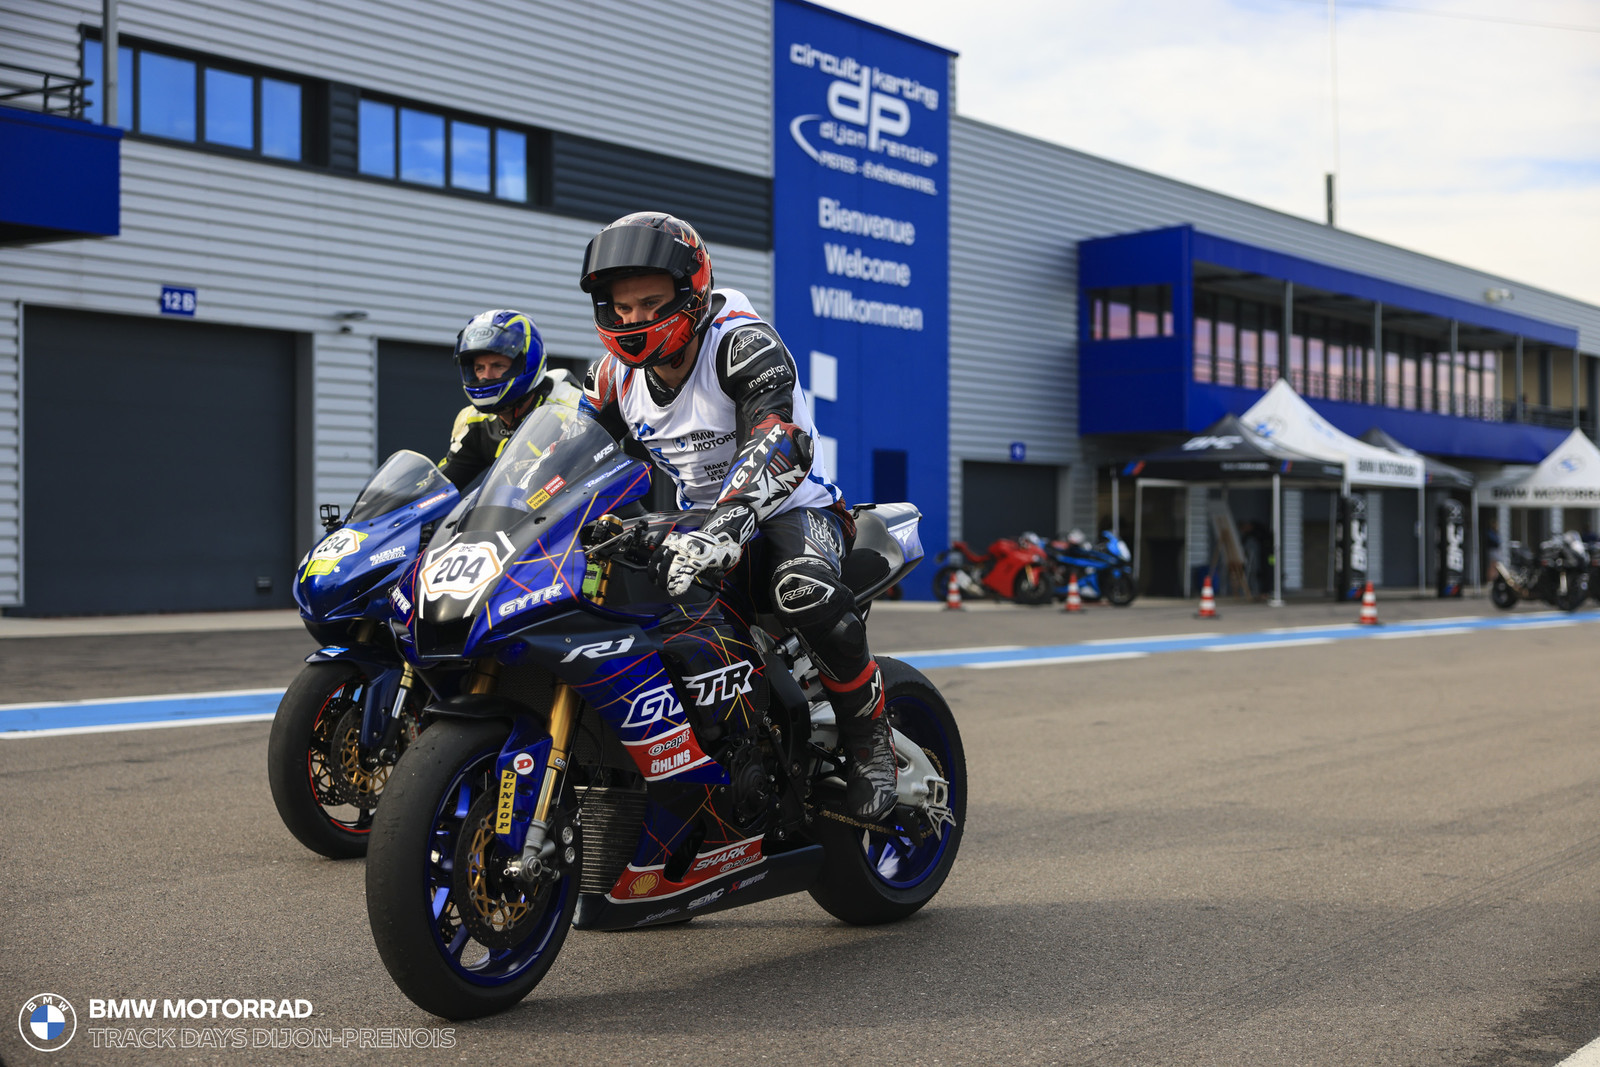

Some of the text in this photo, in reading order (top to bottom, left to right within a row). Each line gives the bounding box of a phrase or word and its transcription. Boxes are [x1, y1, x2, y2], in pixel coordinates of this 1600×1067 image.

[818, 196, 916, 246] Bienvenue
[824, 242, 911, 287] Welcome
[810, 285, 923, 331] Willkommen
[690, 430, 715, 441] BMW
[704, 460, 729, 471] MAKE
[731, 424, 785, 490] GYTR
[707, 469, 725, 477] LIFE
[317, 536, 350, 554] 234
[369, 546, 406, 562] SUZUKI
[432, 555, 486, 584] 204
[499, 582, 564, 617] GYTR
[781, 582, 819, 605] RST
[560, 635, 636, 663] R1
[650, 749, 691, 774] ÖHLINS
[498, 772, 516, 829] DUNLOP
[693, 843, 751, 871] SHARK
